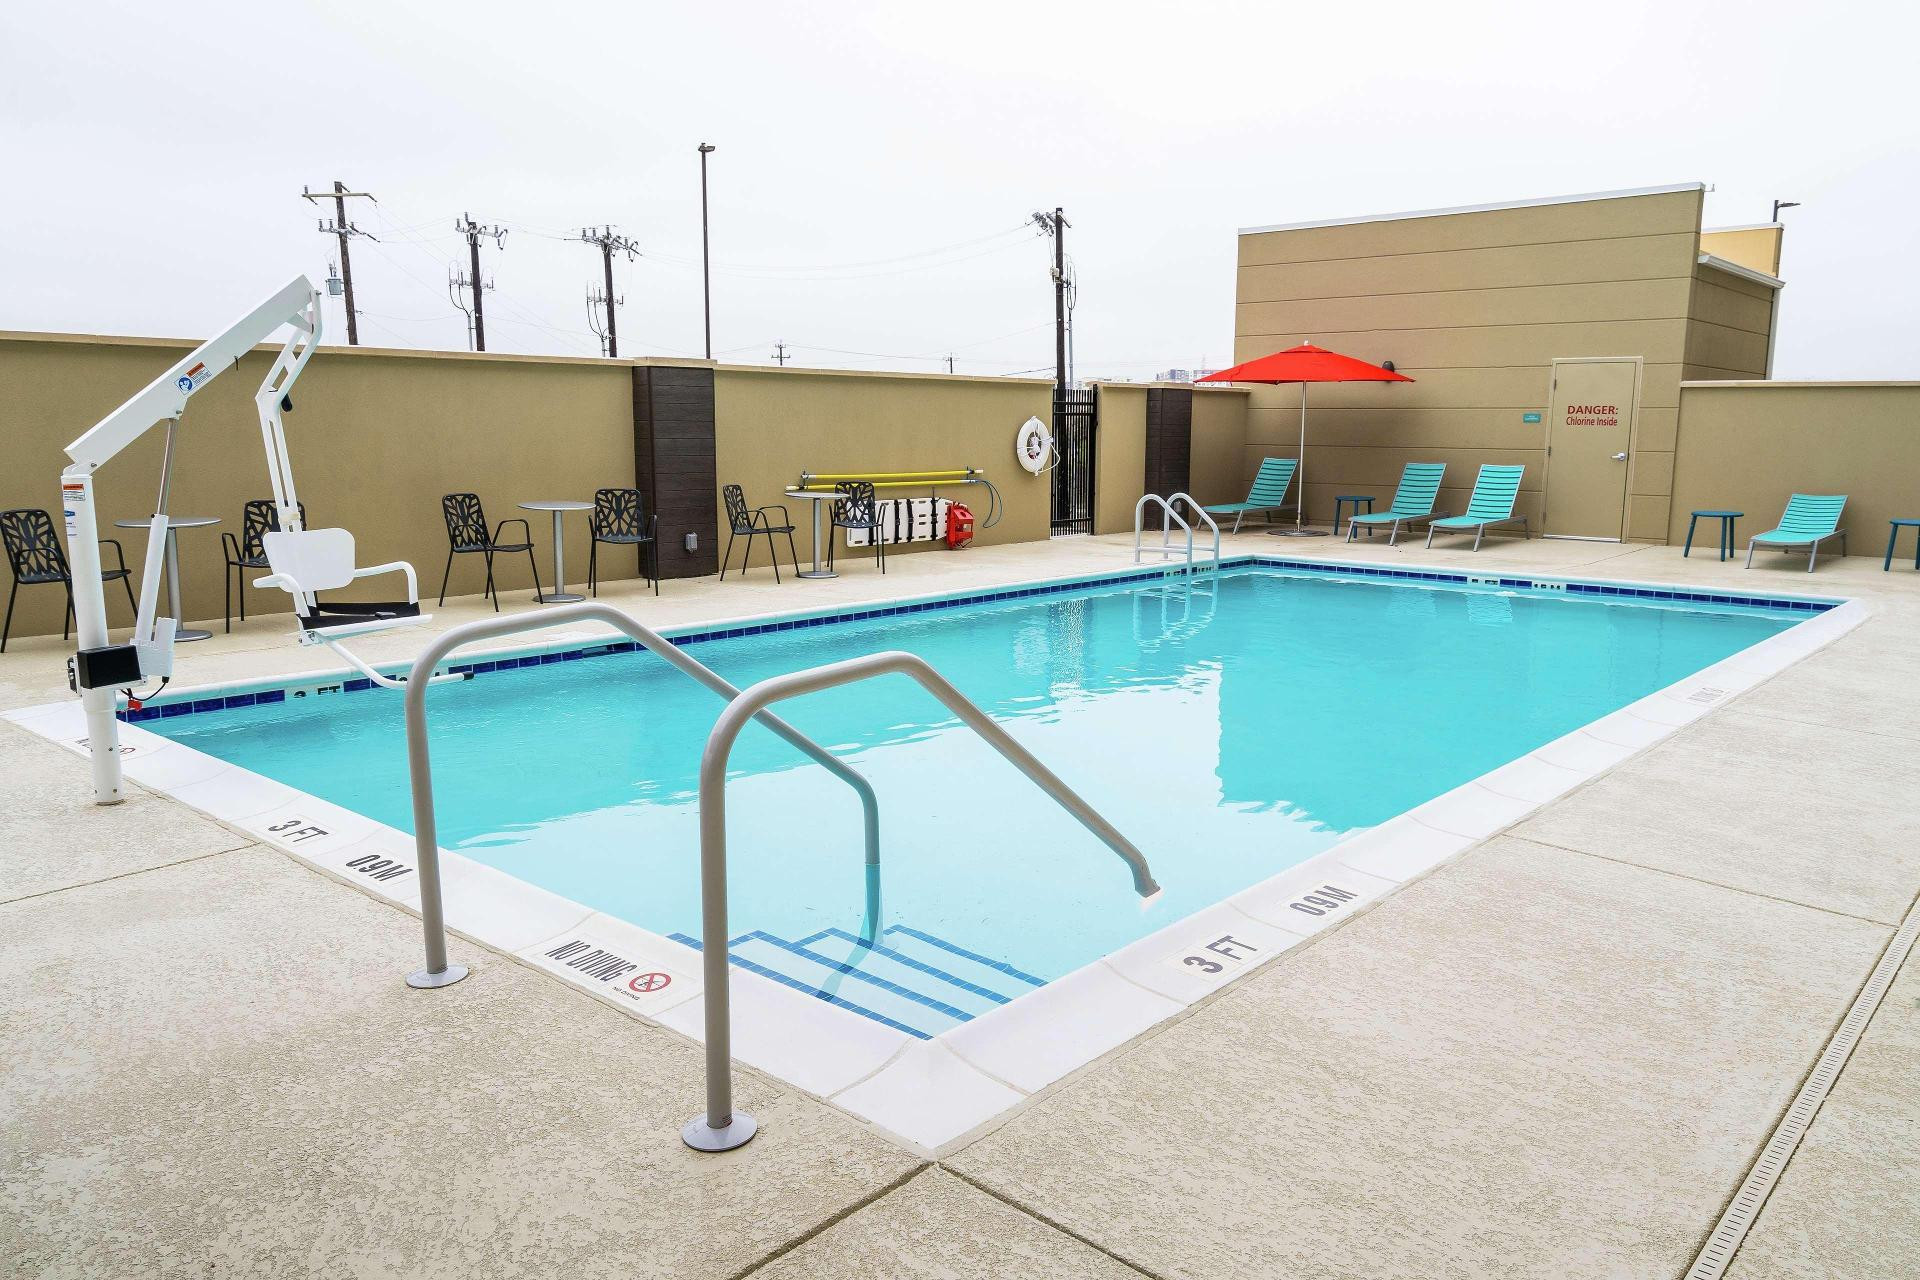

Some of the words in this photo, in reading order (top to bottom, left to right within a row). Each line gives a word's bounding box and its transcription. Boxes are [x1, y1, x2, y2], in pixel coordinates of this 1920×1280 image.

[1567, 405, 1618, 415] DANGER:
[1566, 416, 1595, 426] Chlorine
[1596, 416, 1618, 427] Inside
[268, 820, 302, 832] 3
[282, 826, 329, 843] FT
[544, 940, 591, 961] NO
[1183, 956, 1224, 974] 3
[1205, 935, 1258, 961] FT
[566, 949, 638, 982] DIVING
